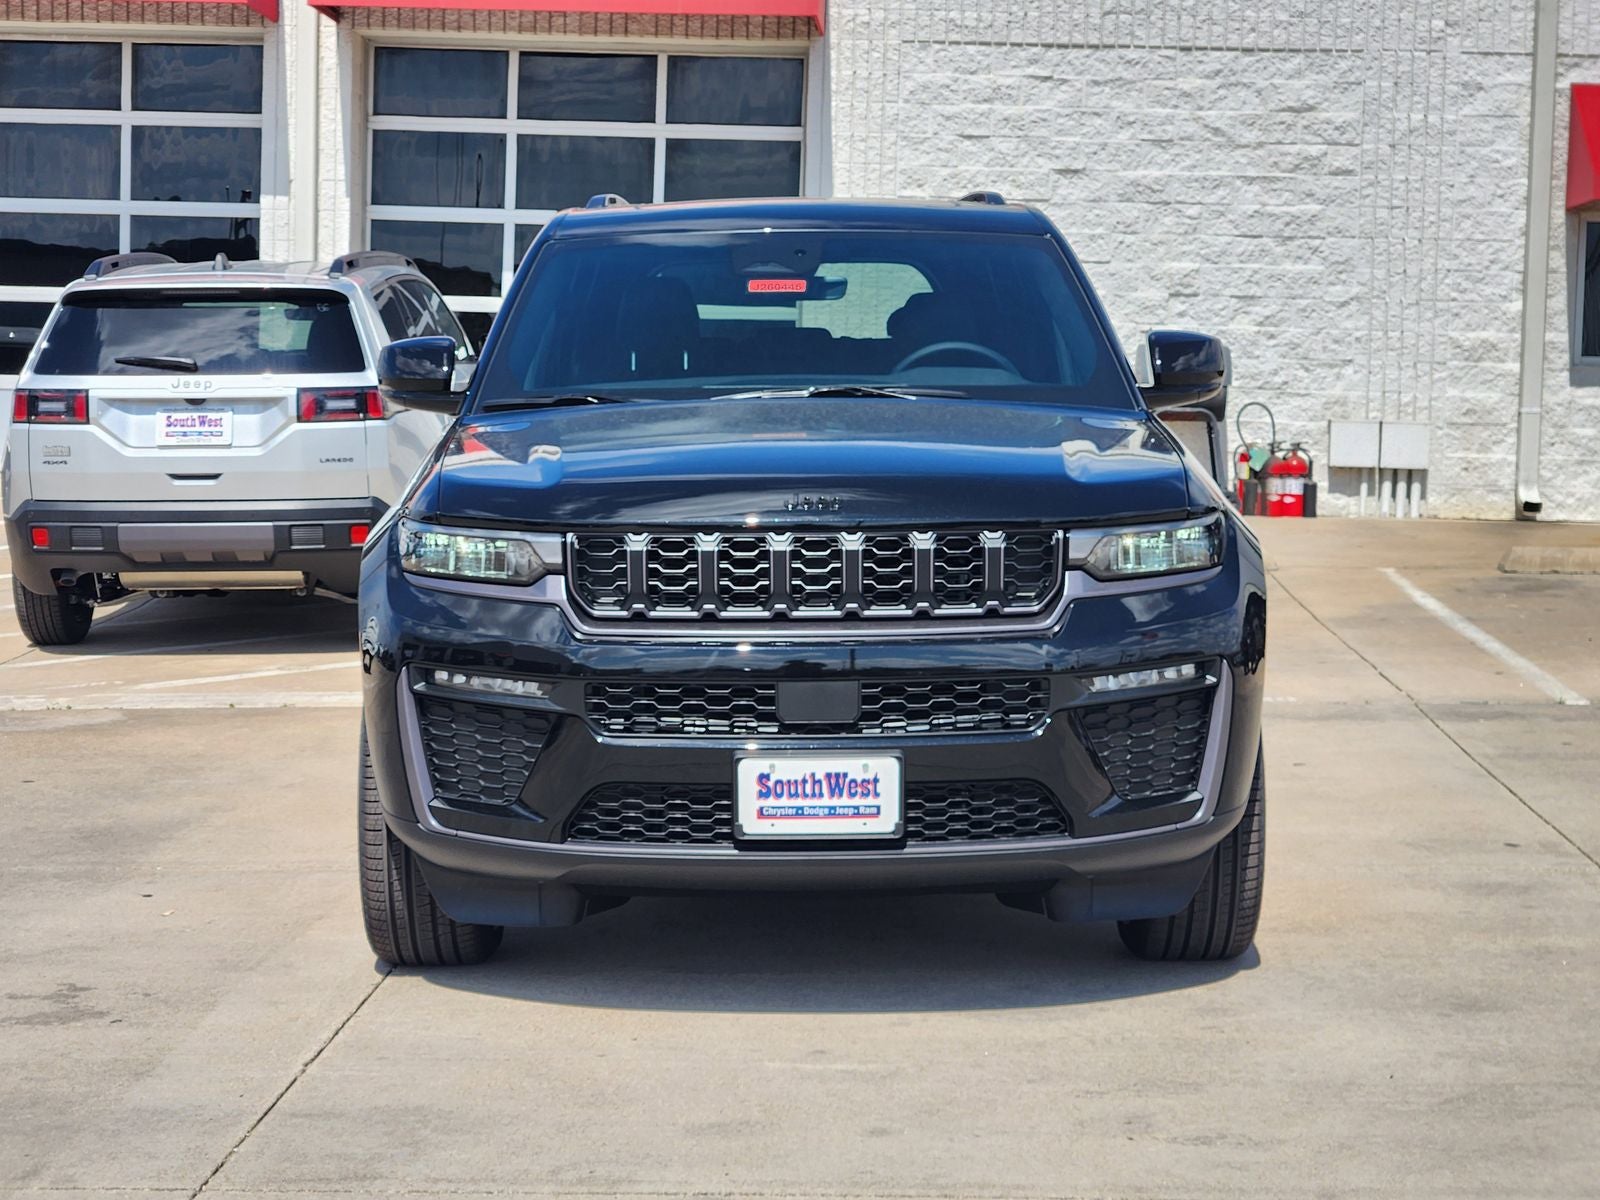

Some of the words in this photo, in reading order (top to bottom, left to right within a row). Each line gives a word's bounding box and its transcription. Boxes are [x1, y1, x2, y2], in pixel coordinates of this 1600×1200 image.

[171, 377, 213, 391] Jeep
[762, 806, 797, 817] Chrysler
[803, 806, 830, 816] Dodge
[835, 805, 854, 816] Jeep
[859, 804, 878, 814] Ram
